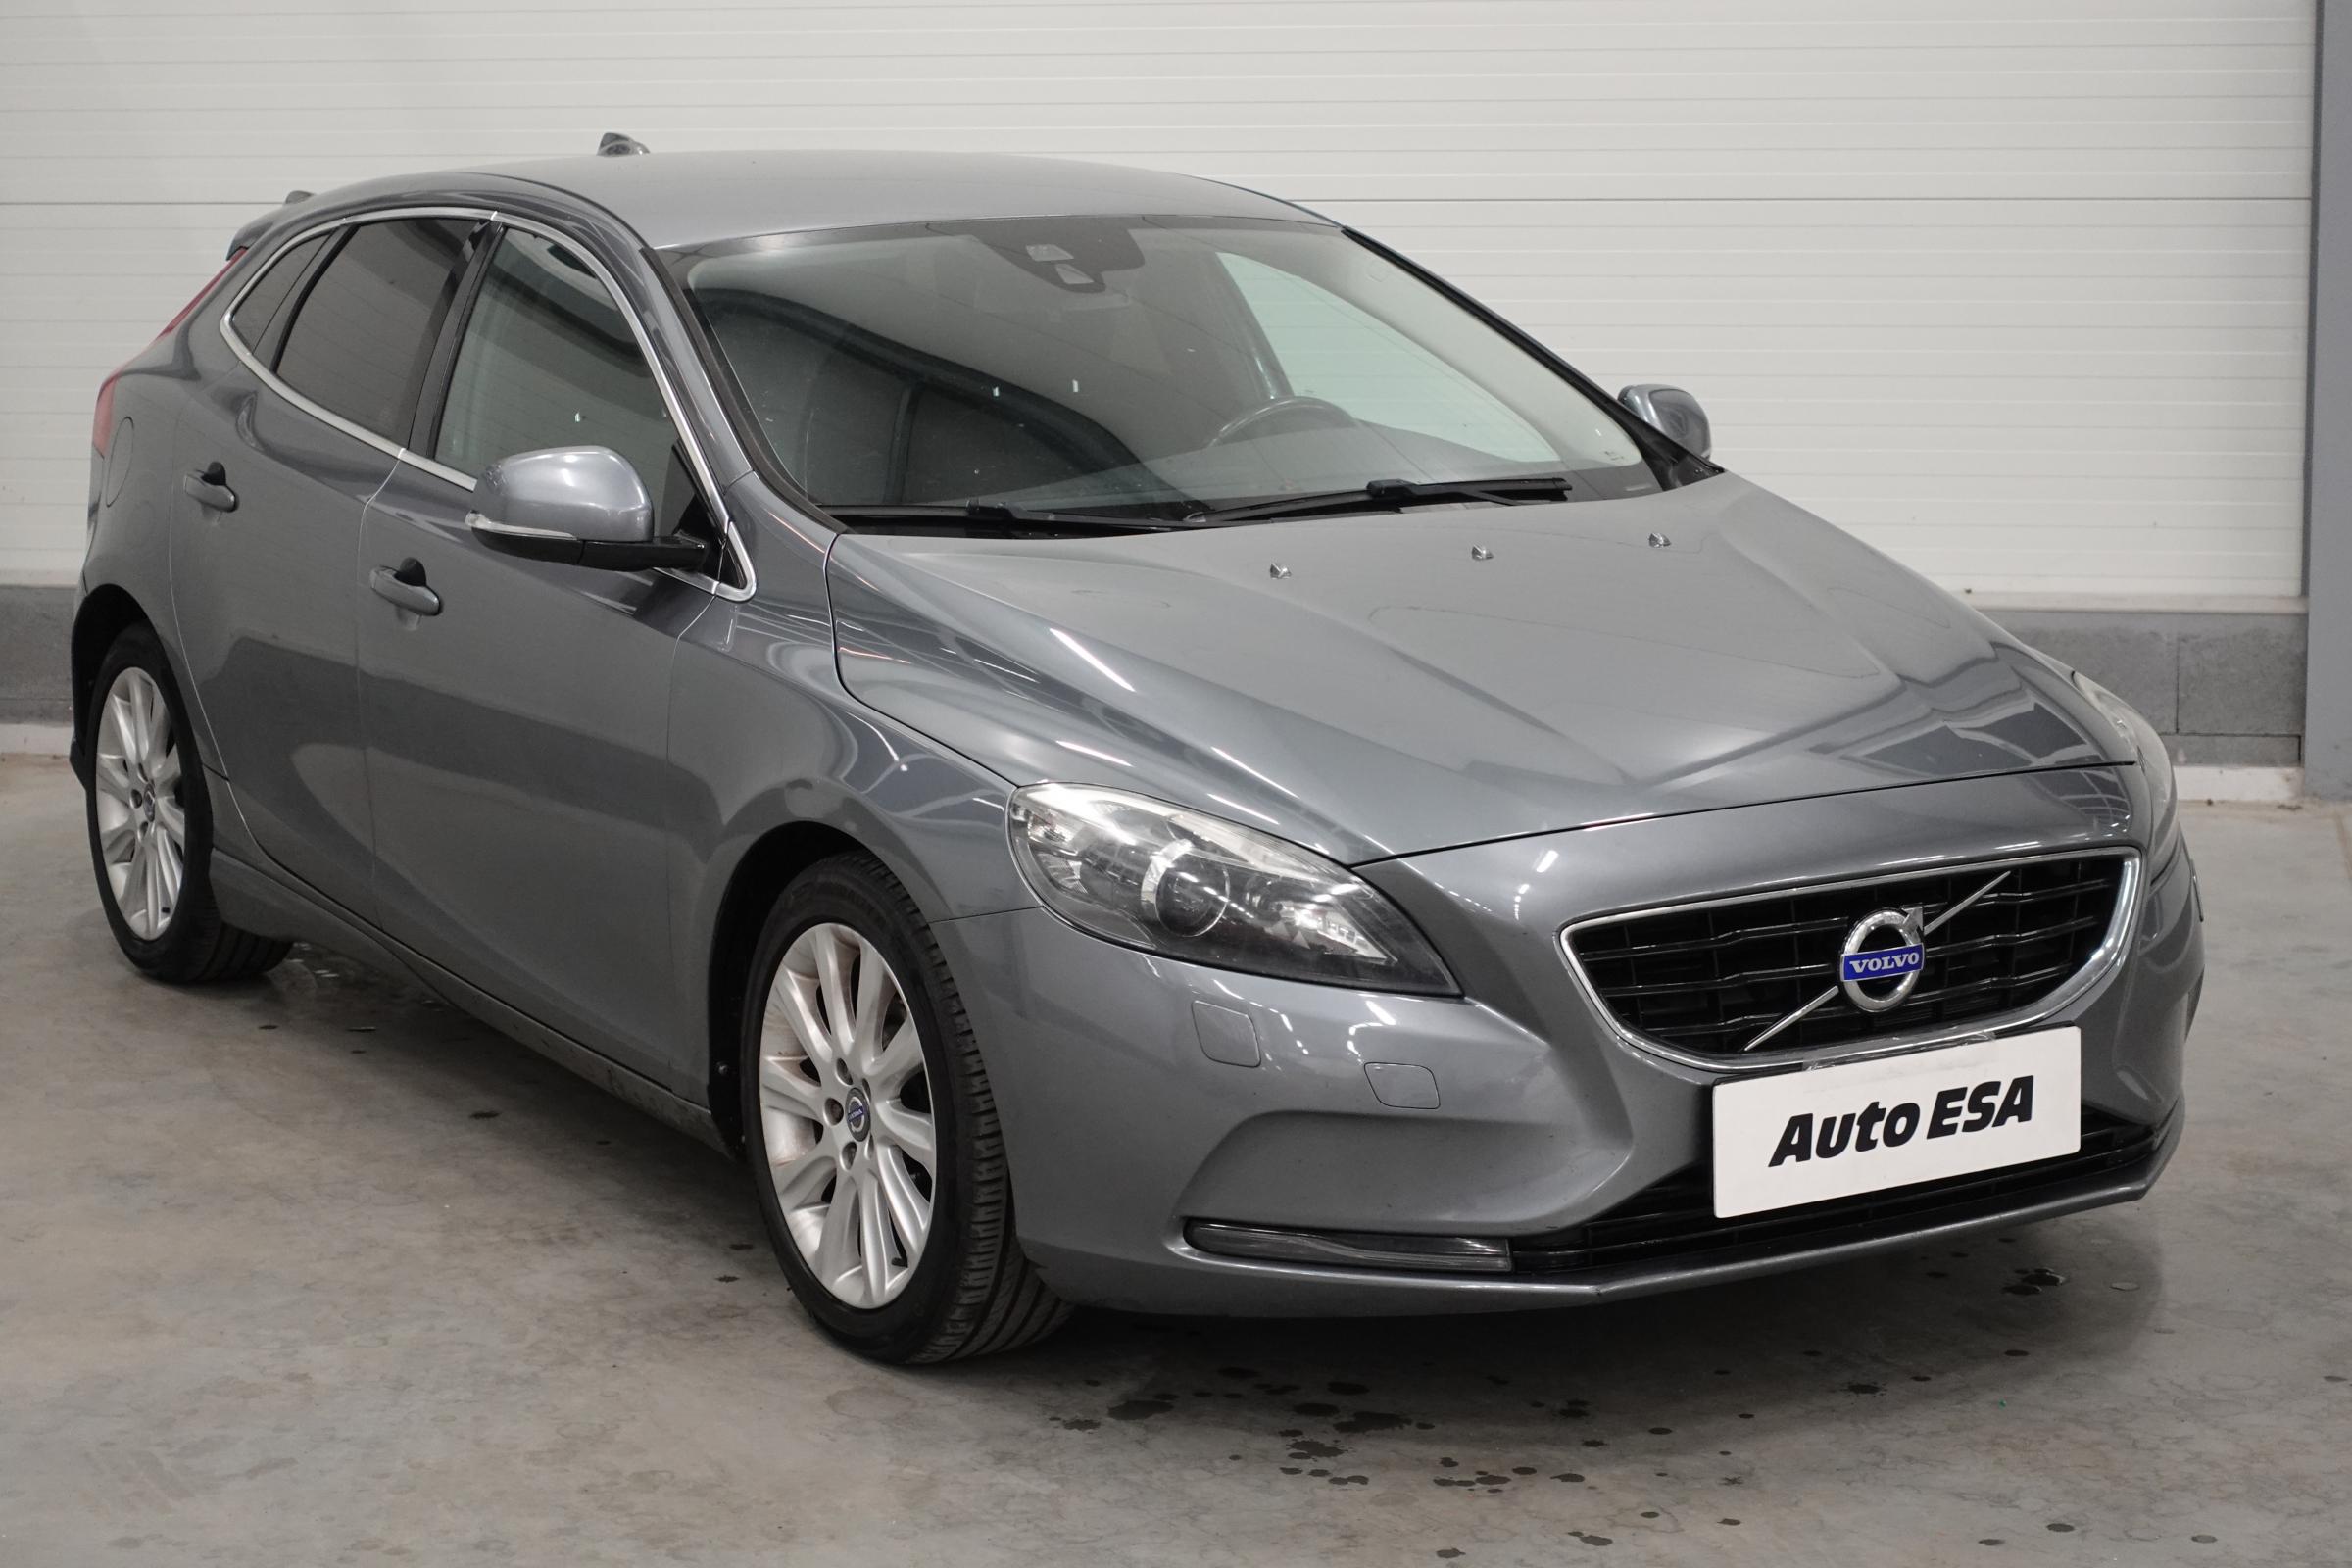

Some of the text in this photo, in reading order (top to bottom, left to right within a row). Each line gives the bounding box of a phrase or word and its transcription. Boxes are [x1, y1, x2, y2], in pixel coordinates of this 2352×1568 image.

[1849, 952, 1920, 973] VOLVO
[1768, 1075, 2034, 1167] Auto ESA
